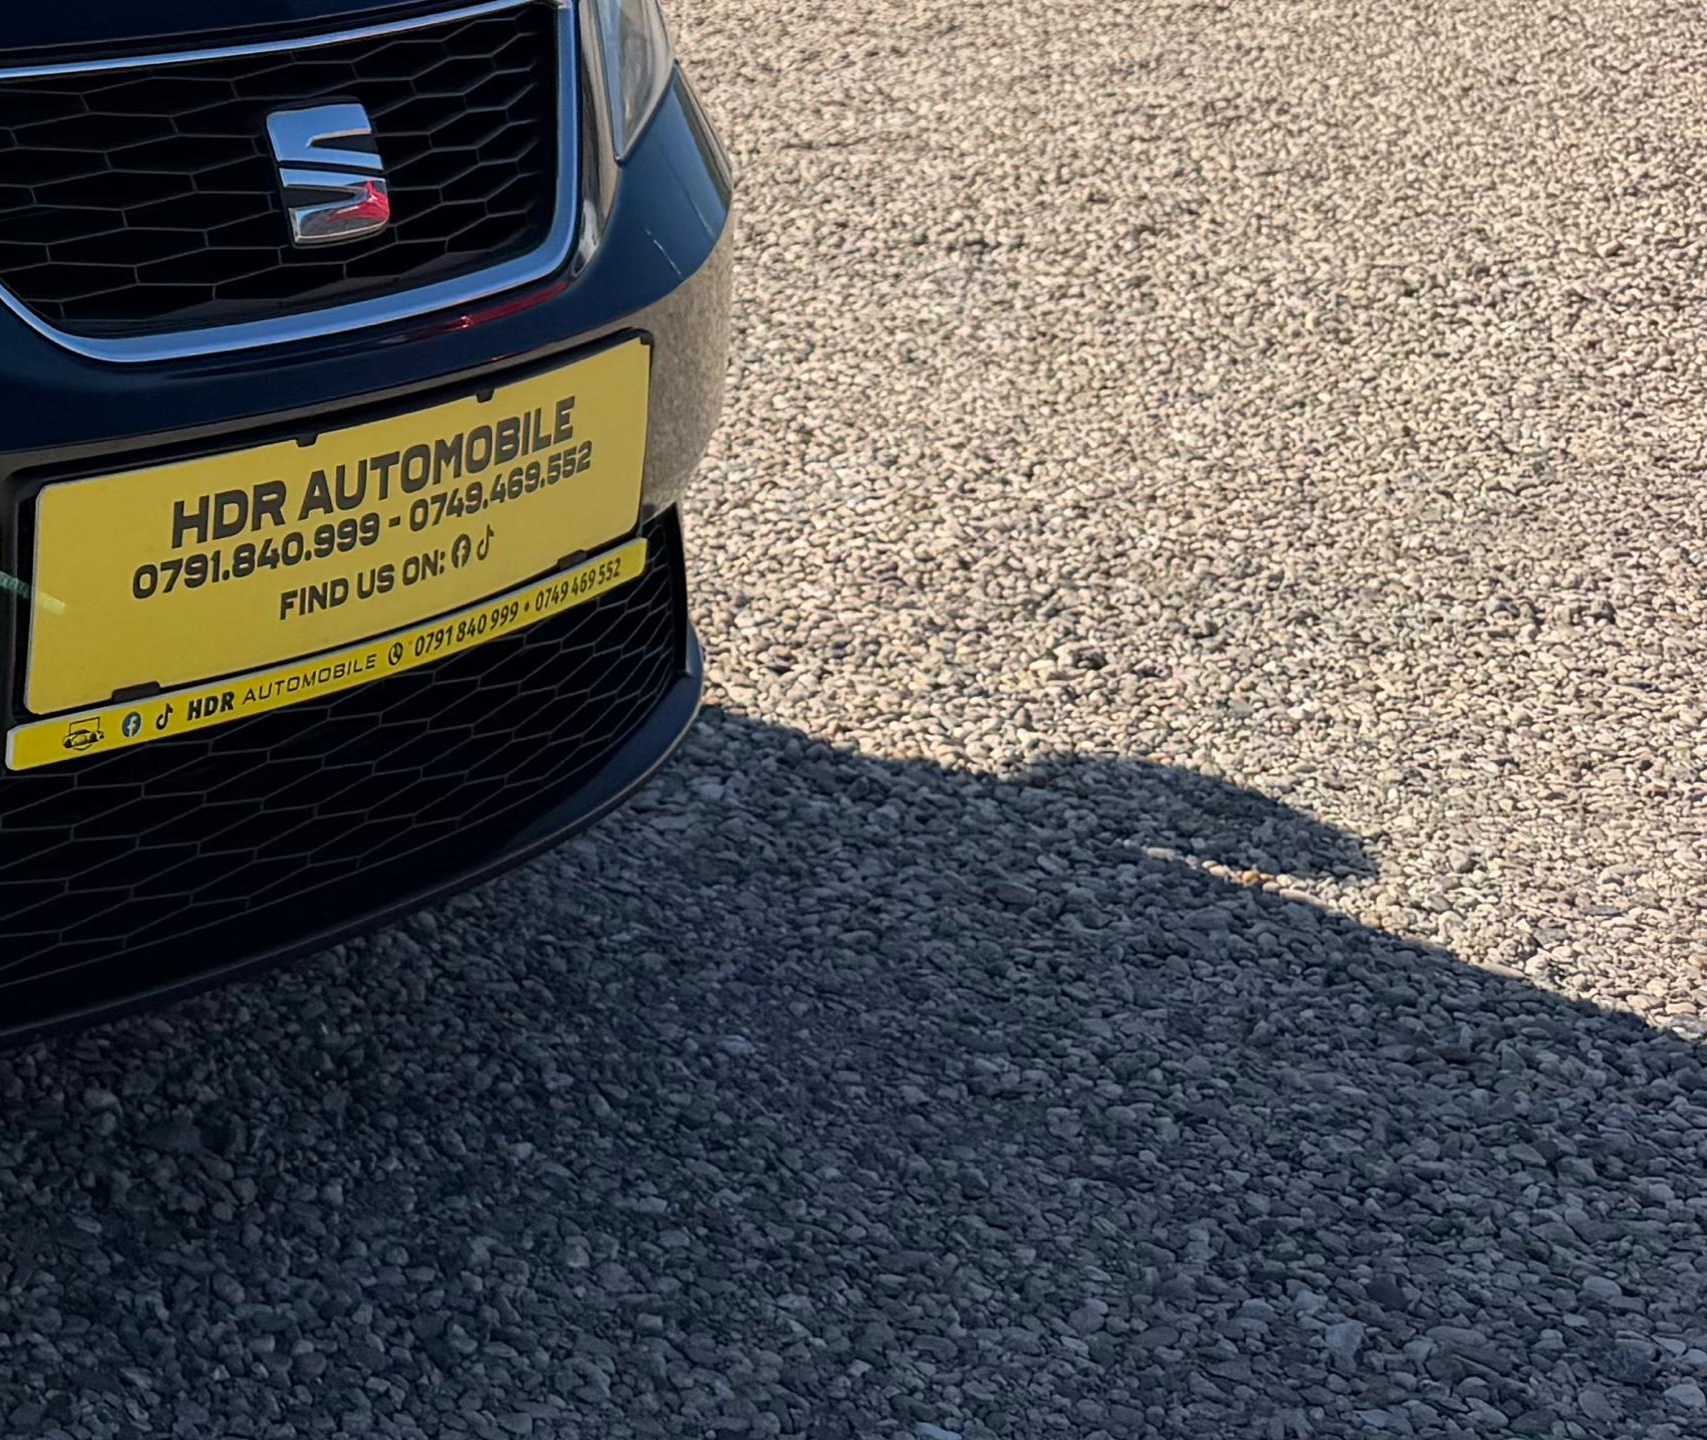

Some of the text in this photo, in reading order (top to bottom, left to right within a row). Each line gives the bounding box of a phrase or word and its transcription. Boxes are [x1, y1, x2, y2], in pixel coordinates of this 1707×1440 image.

[132, 512, 381, 600] 0791.840.999
[408, 440, 593, 532] 0749.469.552
[172, 395, 576, 549] HDR AUTOMOBILE
[187, 557, 621, 721] HDR AUTOMOBILE 0791 840 999 0749 469 552
[279, 549, 446, 620] FIND US ON:
